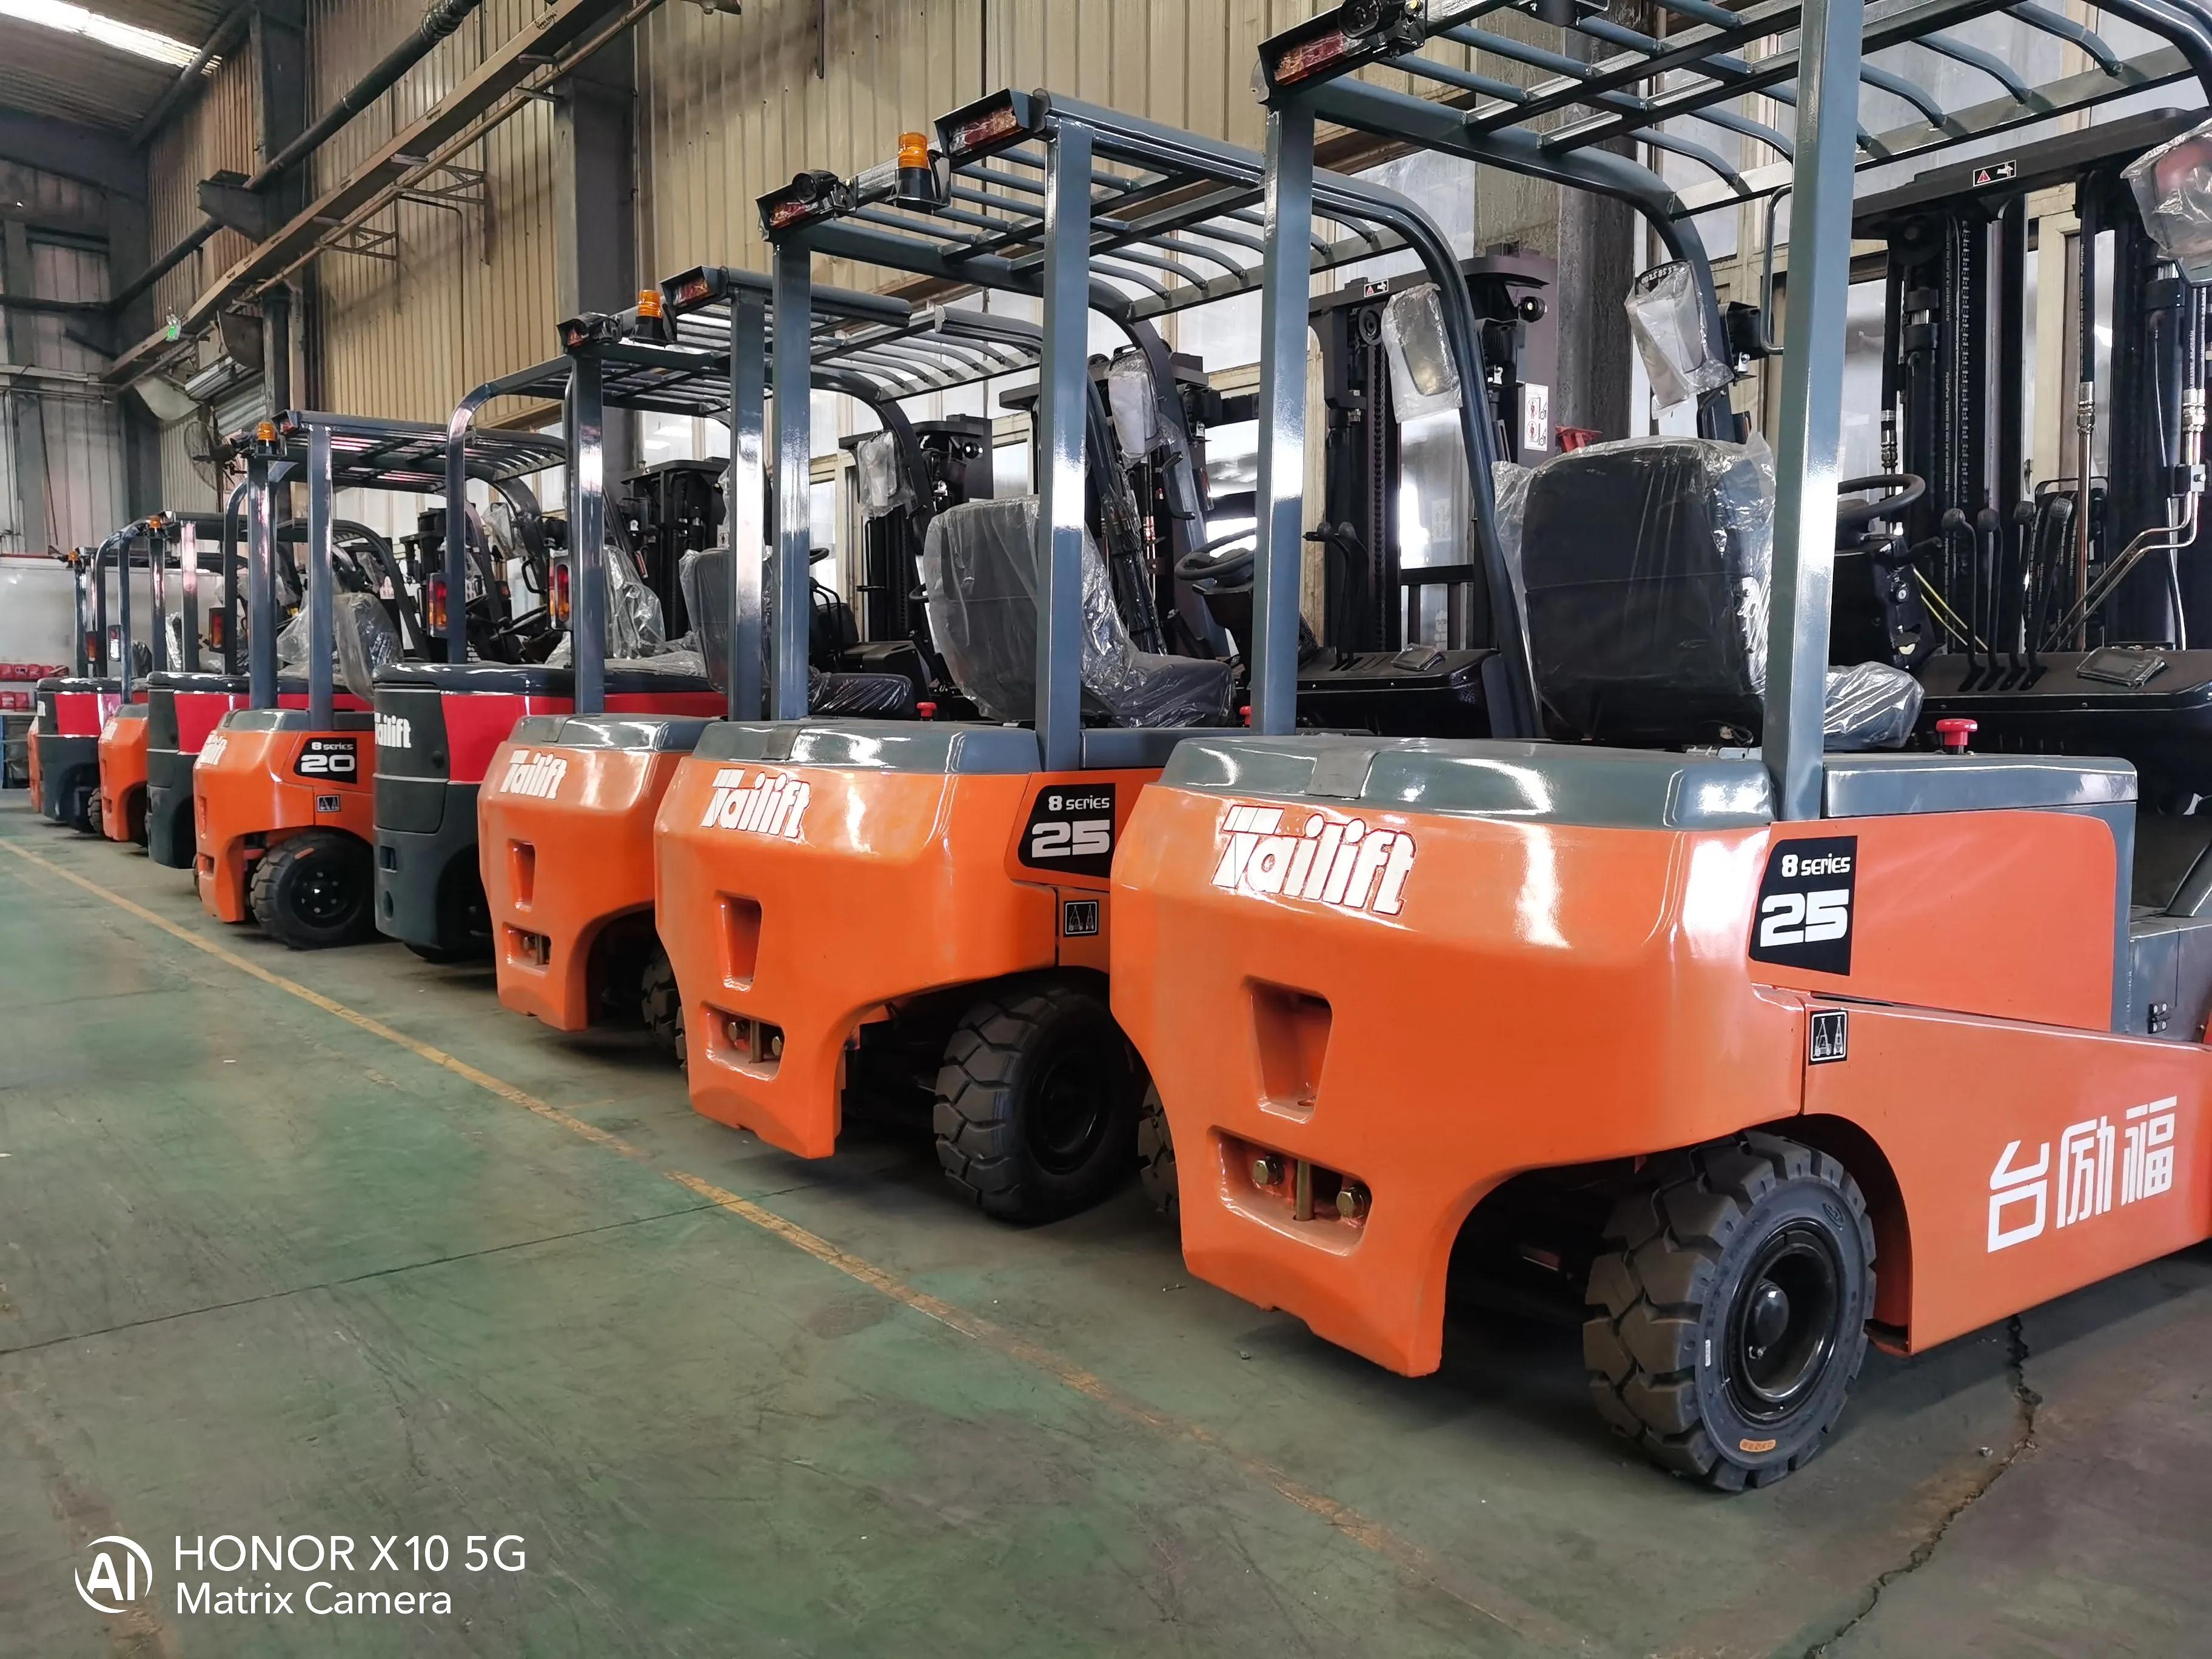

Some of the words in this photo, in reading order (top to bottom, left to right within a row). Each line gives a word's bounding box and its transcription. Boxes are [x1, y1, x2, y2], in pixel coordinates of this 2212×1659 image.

[301, 754, 355, 773] 20
[312, 742, 322, 751] 8
[500, 749, 568, 800] Tailift
[700, 768, 811, 840] Tailift
[1049, 796, 1063, 811] 8
[1066, 794, 1110, 811] series
[1031, 820, 1110, 858] 25
[1211, 804, 1418, 917] Tailift
[1781, 854, 1799, 878] 8
[1800, 853, 1851, 877] series
[1759, 888, 1850, 948] 25
[1987, 1095, 2178, 1254] 台励福
